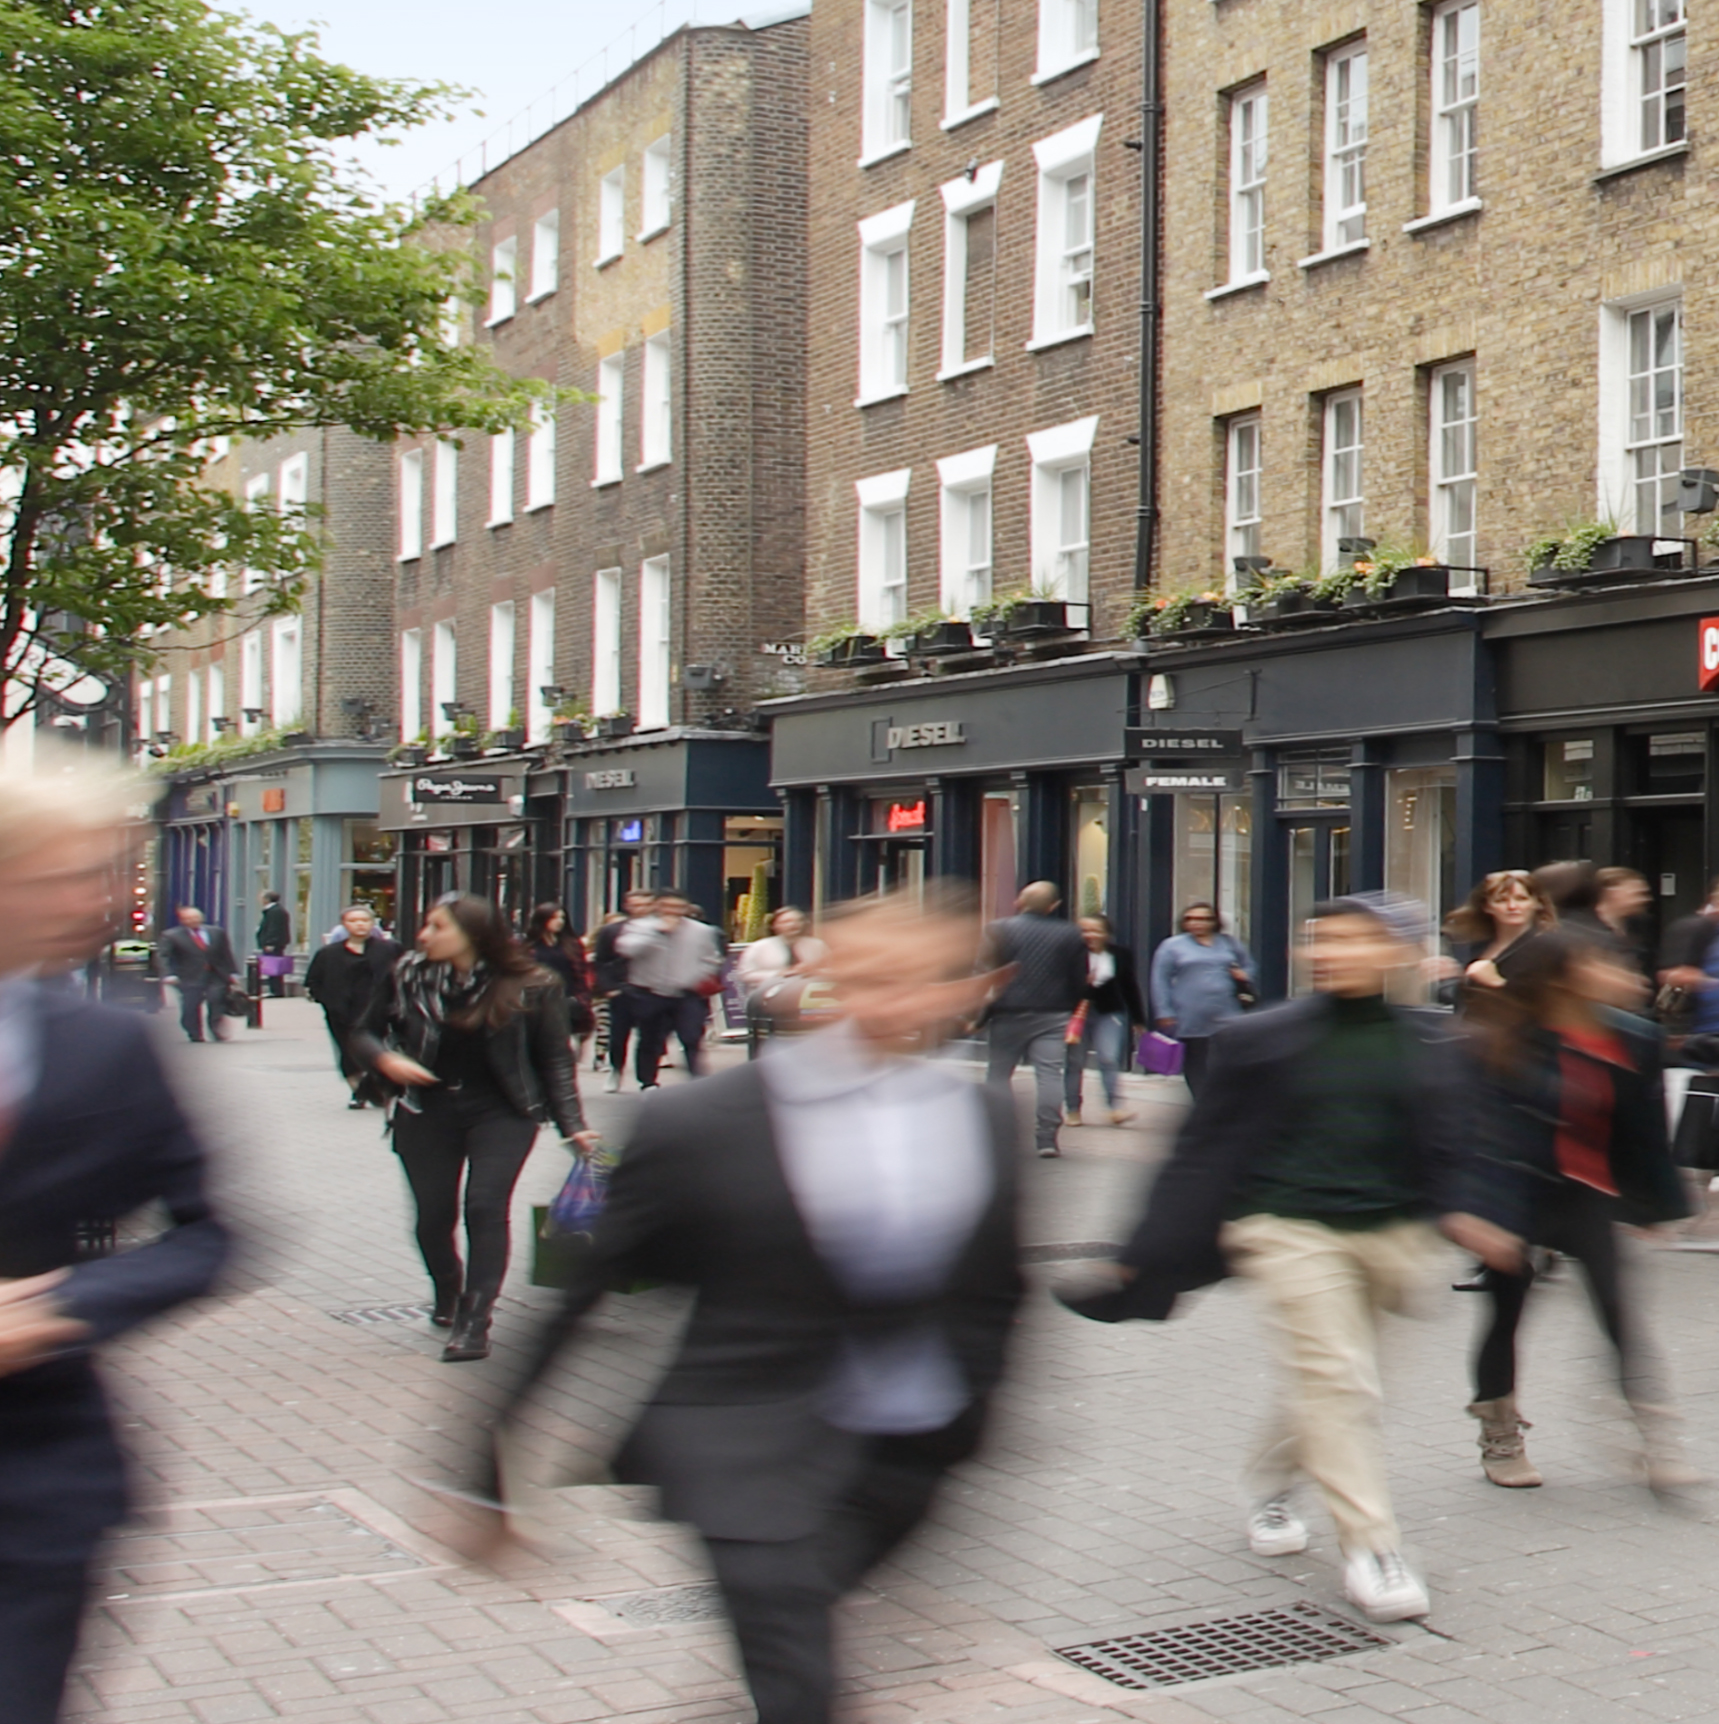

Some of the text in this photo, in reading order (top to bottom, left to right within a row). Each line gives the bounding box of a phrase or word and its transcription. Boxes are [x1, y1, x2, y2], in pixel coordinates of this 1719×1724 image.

[886, 721, 967, 749] DIESEL
[1141, 738, 1224, 749] DIESEL
[1145, 776, 1227, 787] FEMALE
